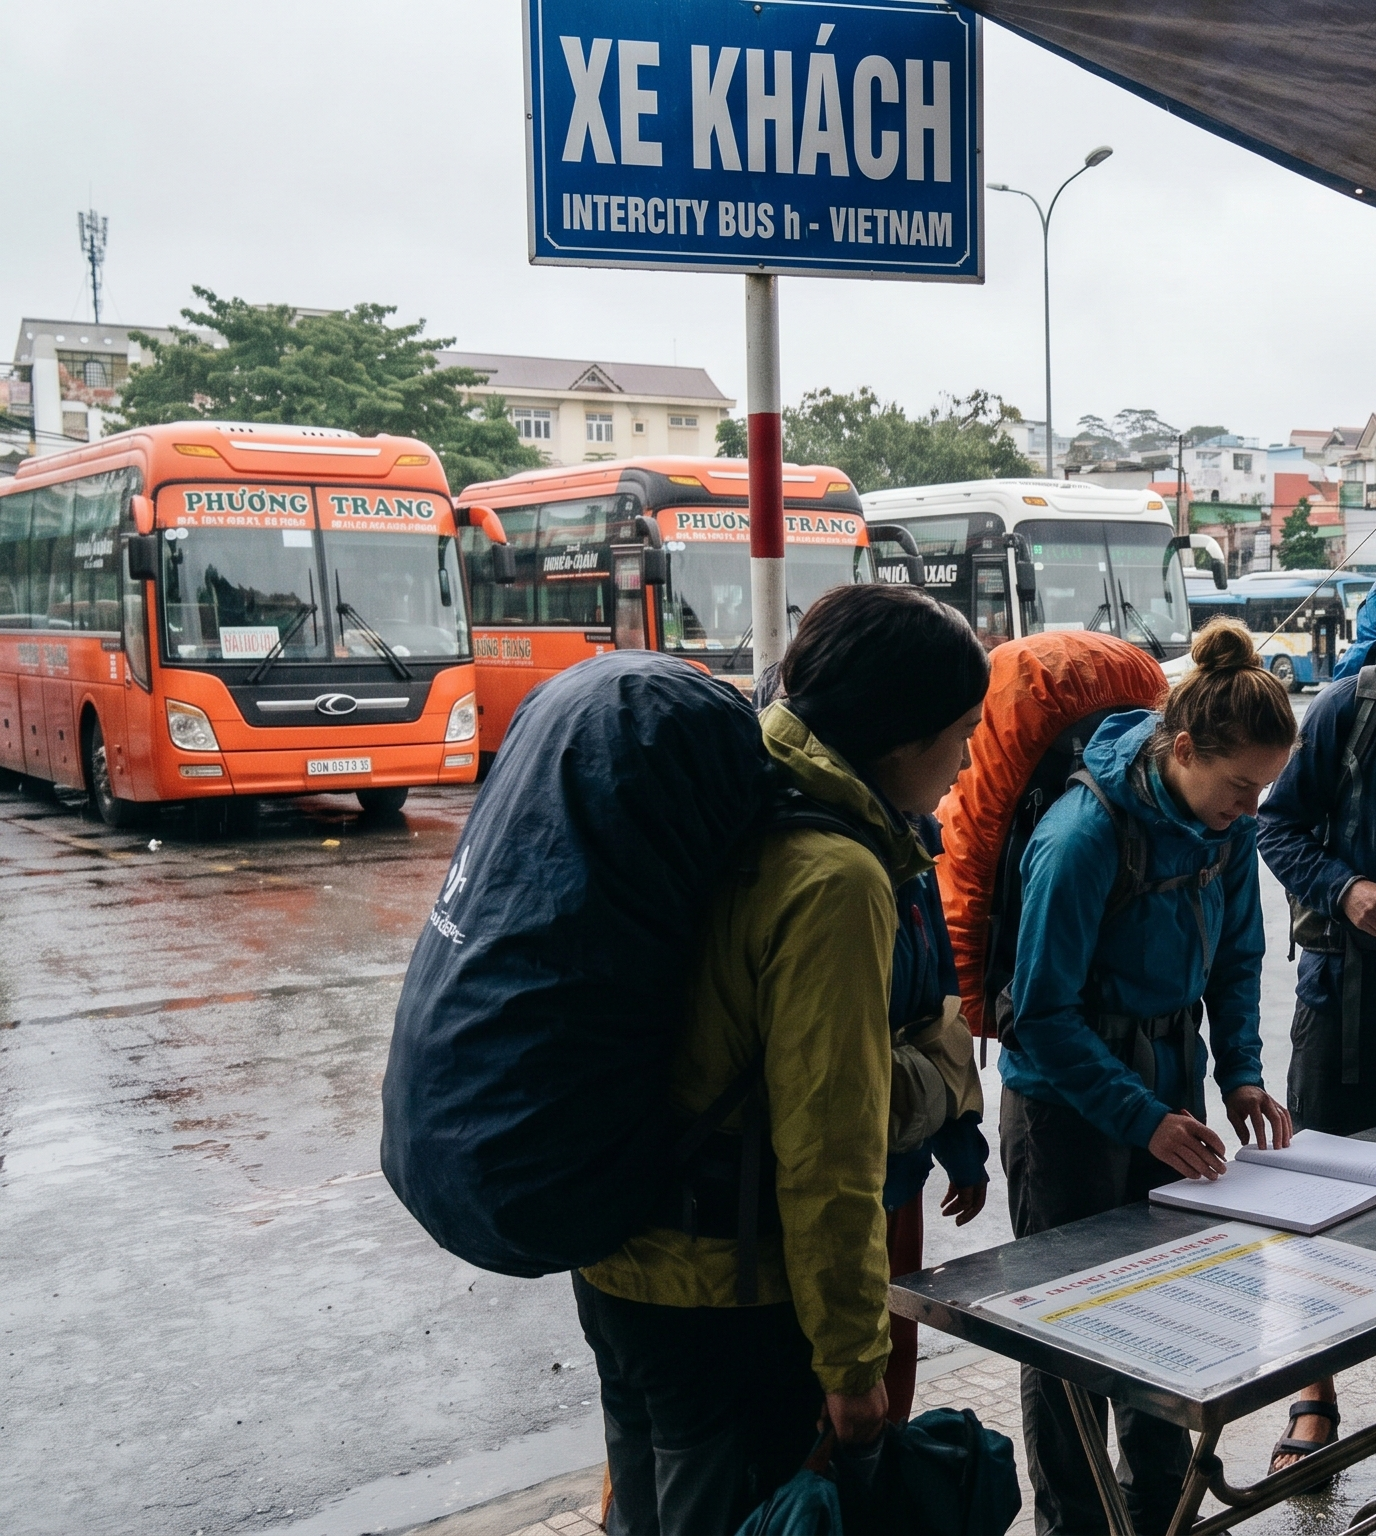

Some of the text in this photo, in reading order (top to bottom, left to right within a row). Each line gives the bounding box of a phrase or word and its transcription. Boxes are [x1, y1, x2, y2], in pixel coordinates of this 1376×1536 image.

[559, 23, 952, 182] XE KHÁCH
[562, 193, 710, 236] INTERCITY
[719, 201, 775, 239] BUS
[784, 205, 801, 240] h
[829, 206, 953, 248] VIETNAM
[184, 488, 435, 519] PHƯƠNG TRANG
[676, 511, 857, 534] PHƯƠN TRANG
